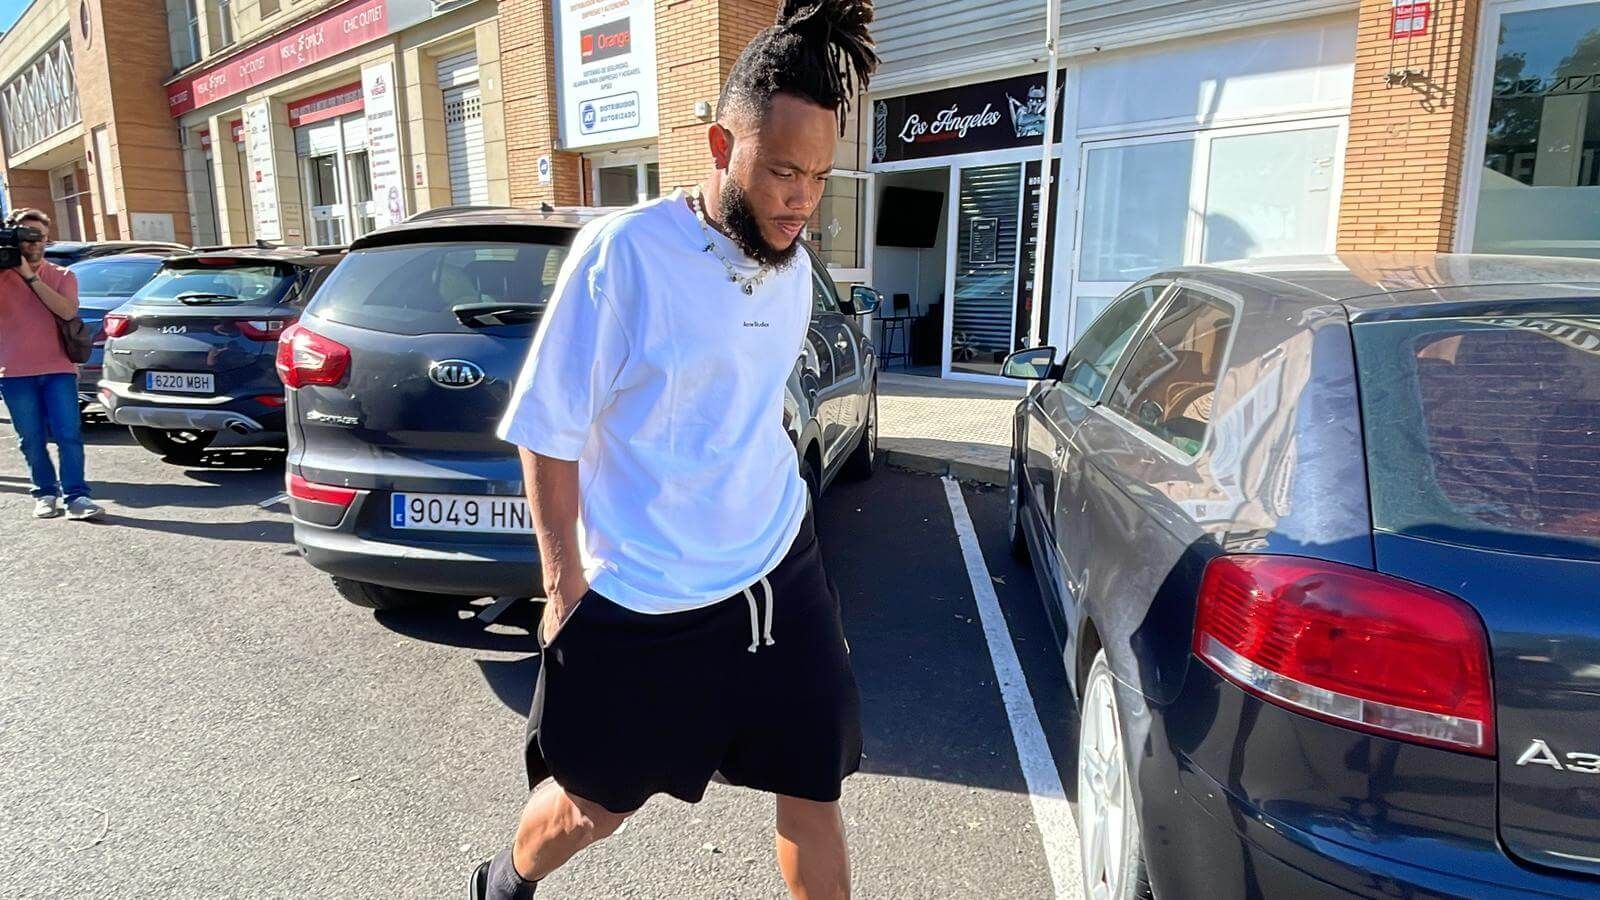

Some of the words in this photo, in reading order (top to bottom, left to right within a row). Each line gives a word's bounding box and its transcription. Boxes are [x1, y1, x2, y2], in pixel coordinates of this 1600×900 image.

[597, 31, 630, 48] Orange
[600, 100, 635, 112] DISTRIBUIDOR
[600, 111, 636, 123] AUTORIZADO
[898, 113, 928, 143] Los
[930, 103, 1002, 138] Ángeles
[155, 375, 184, 388] 6220
[186, 376, 209, 389] MBH
[436, 367, 474, 383] KIA
[411, 498, 479, 526] 9049
[491, 501, 533, 529] HN
[1515, 738, 1600, 774] A3
